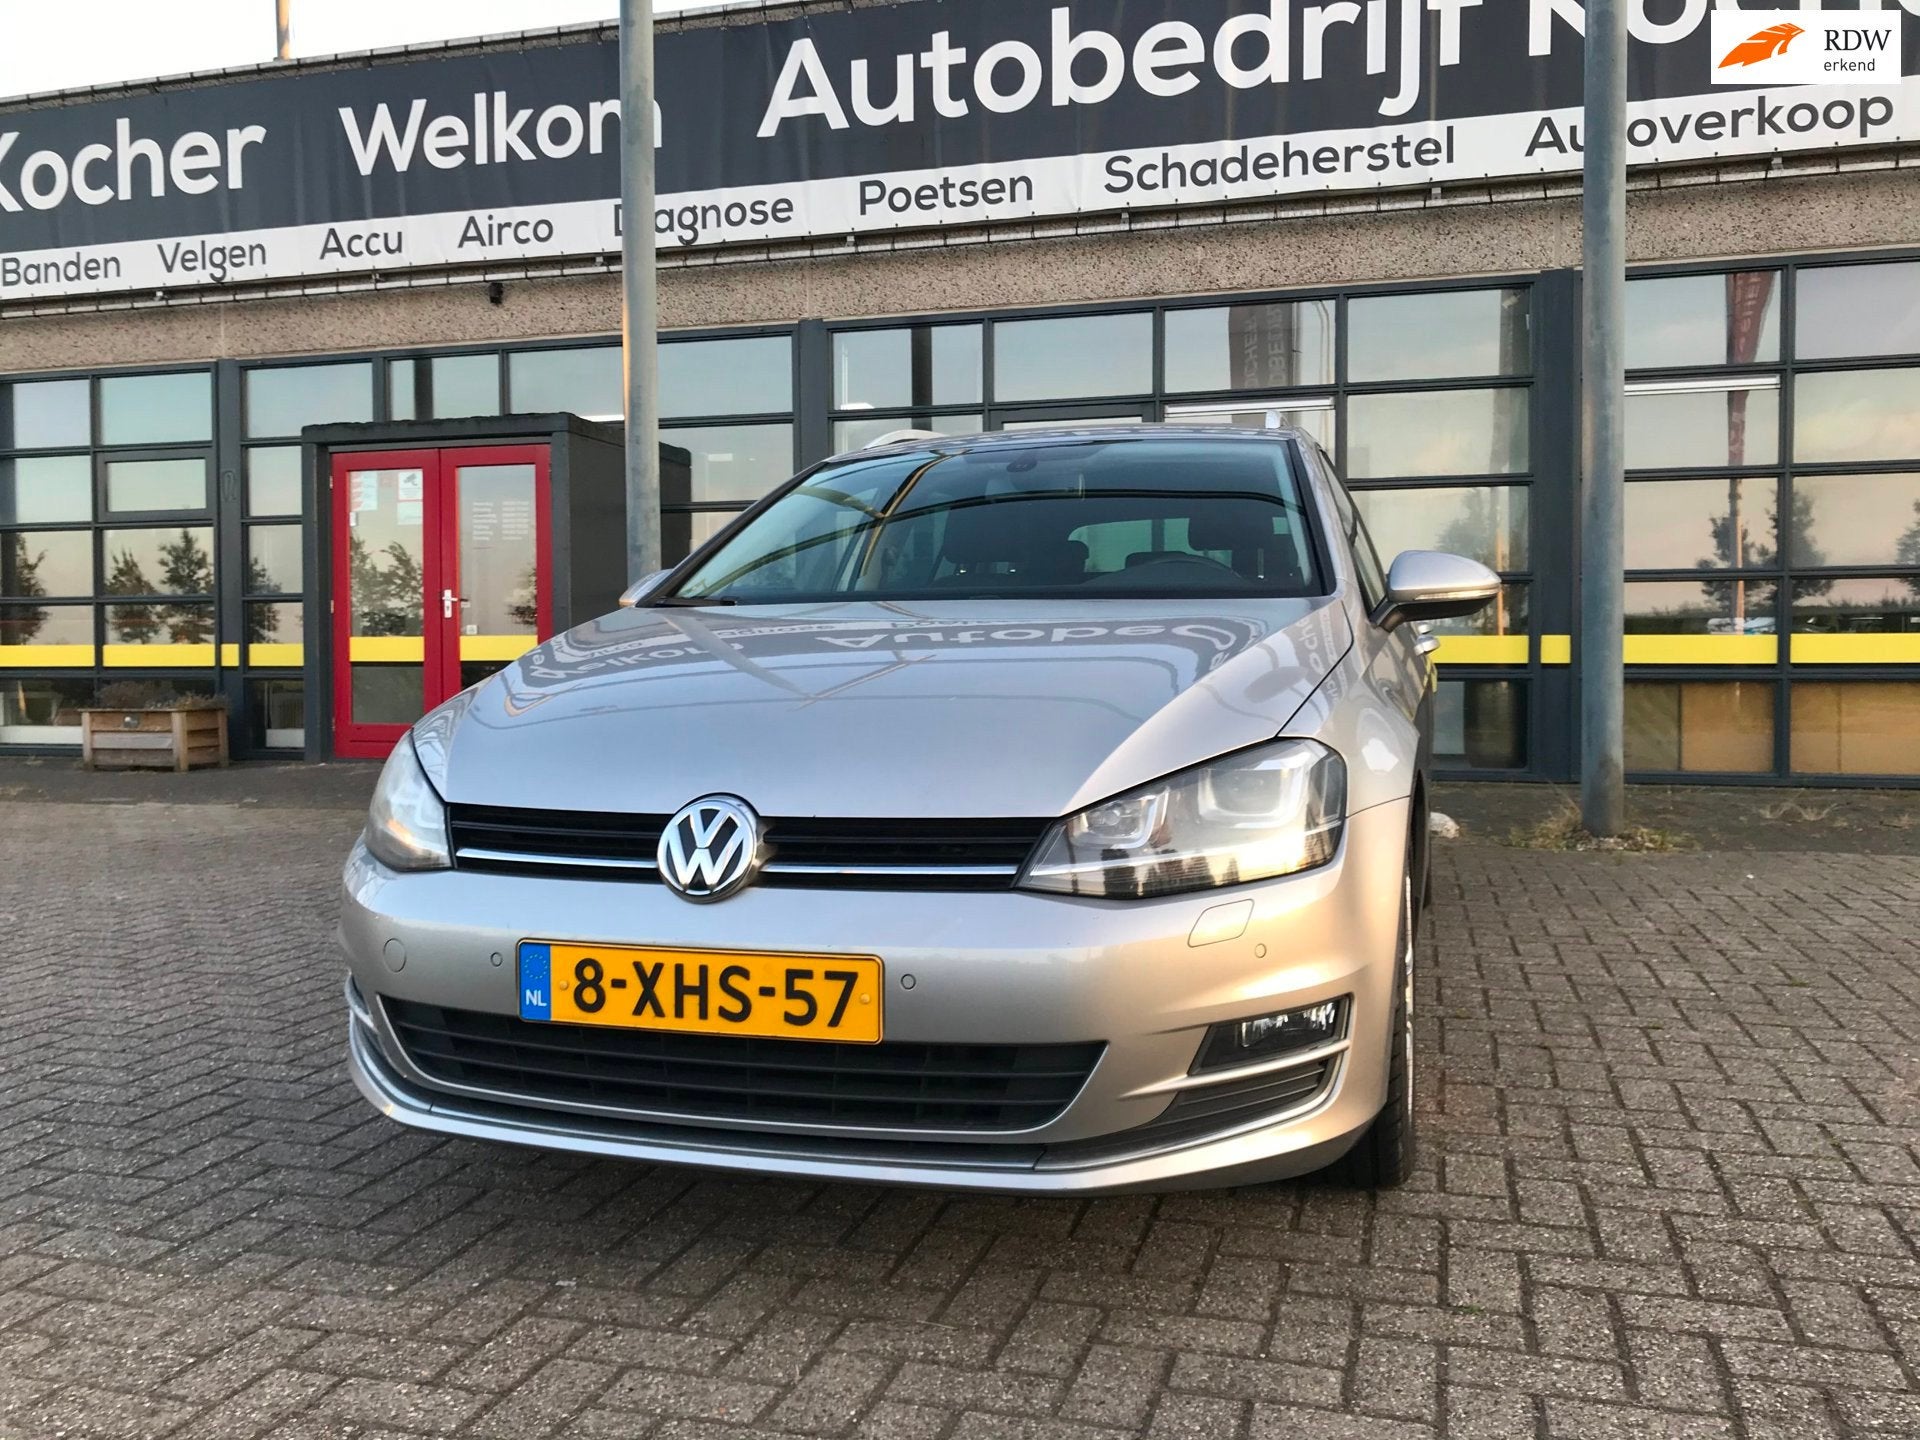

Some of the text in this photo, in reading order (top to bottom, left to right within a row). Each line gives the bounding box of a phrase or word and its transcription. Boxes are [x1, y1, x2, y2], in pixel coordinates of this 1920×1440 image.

[756, 0, 1484, 137] Autobedrijf
[1, 95, 1894, 287] Banden Velgen Accu Airco agnose Poetsen Schadeherstel Auoverkoop
[525, 957, 859, 1028] NL 8-XHS-57
